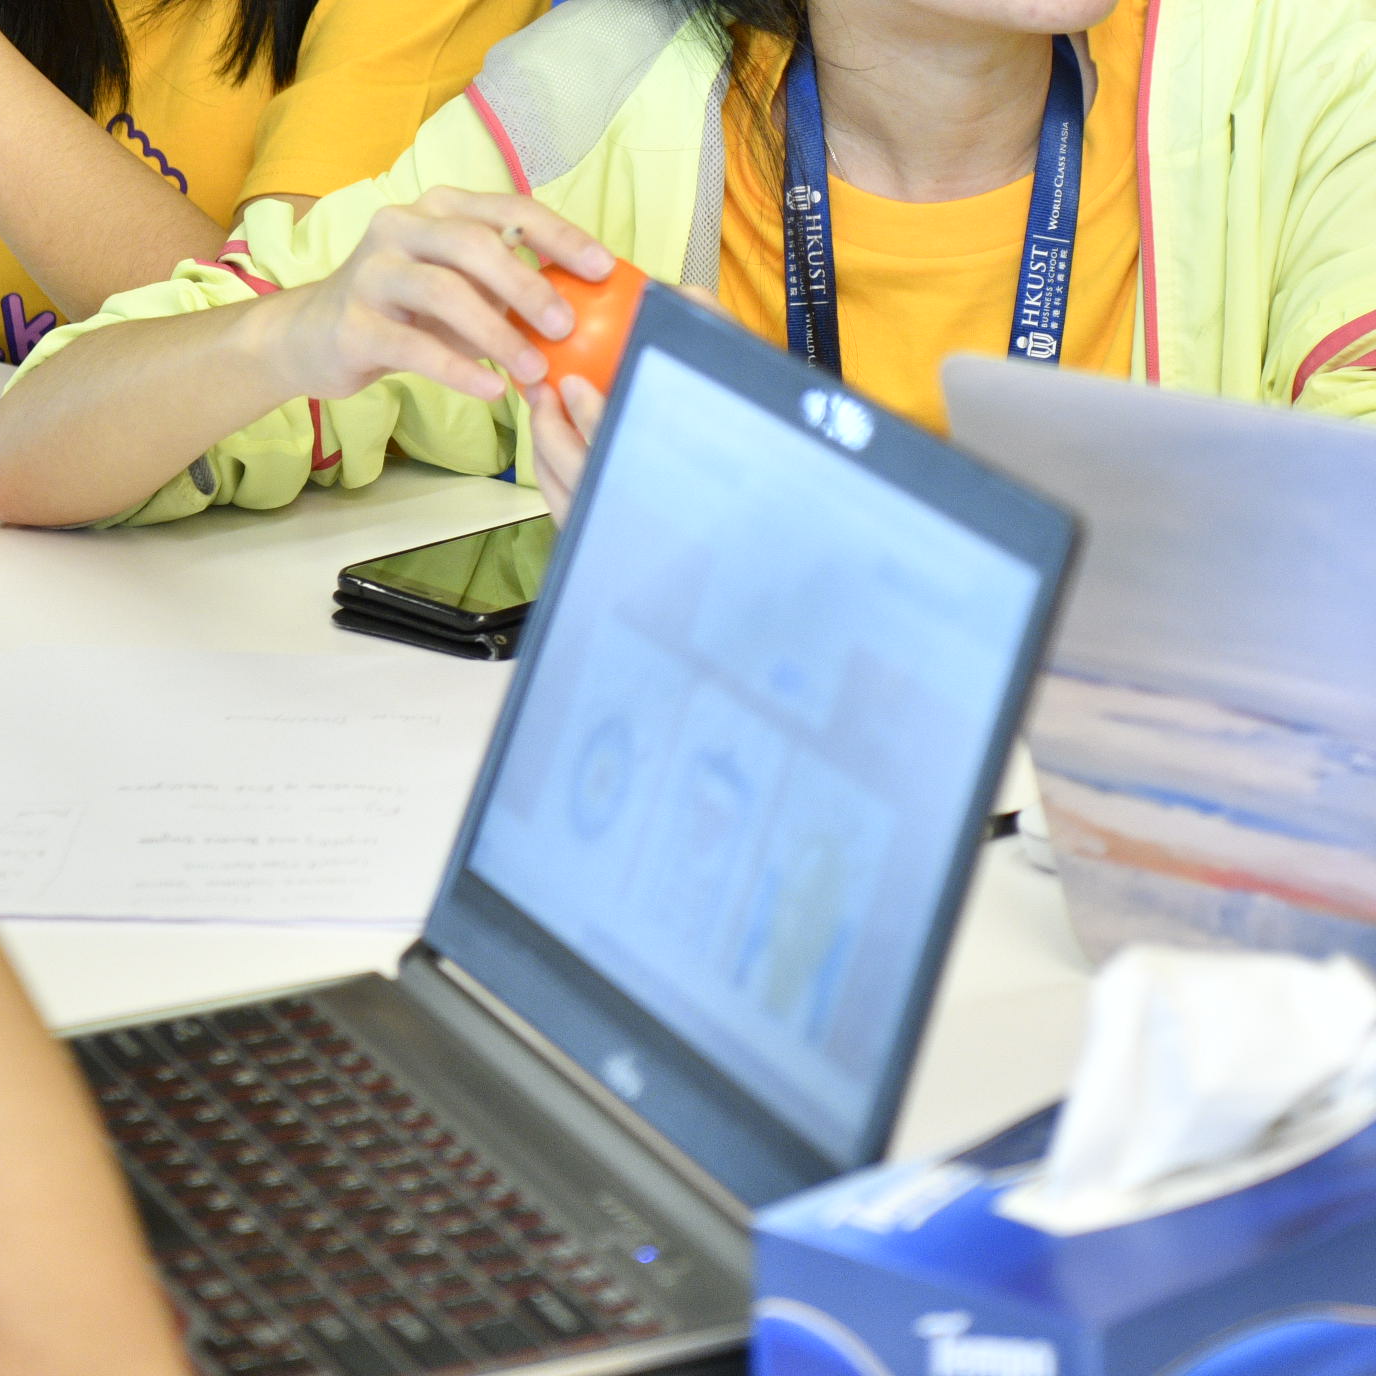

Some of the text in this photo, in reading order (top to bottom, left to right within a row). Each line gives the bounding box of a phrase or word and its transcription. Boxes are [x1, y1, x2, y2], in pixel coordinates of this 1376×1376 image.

[805, 214, 827, 295] HKUST
[1021, 245, 1049, 327] HKUST
[1041, 247, 1059, 328] BUSINESS SCHOOL
